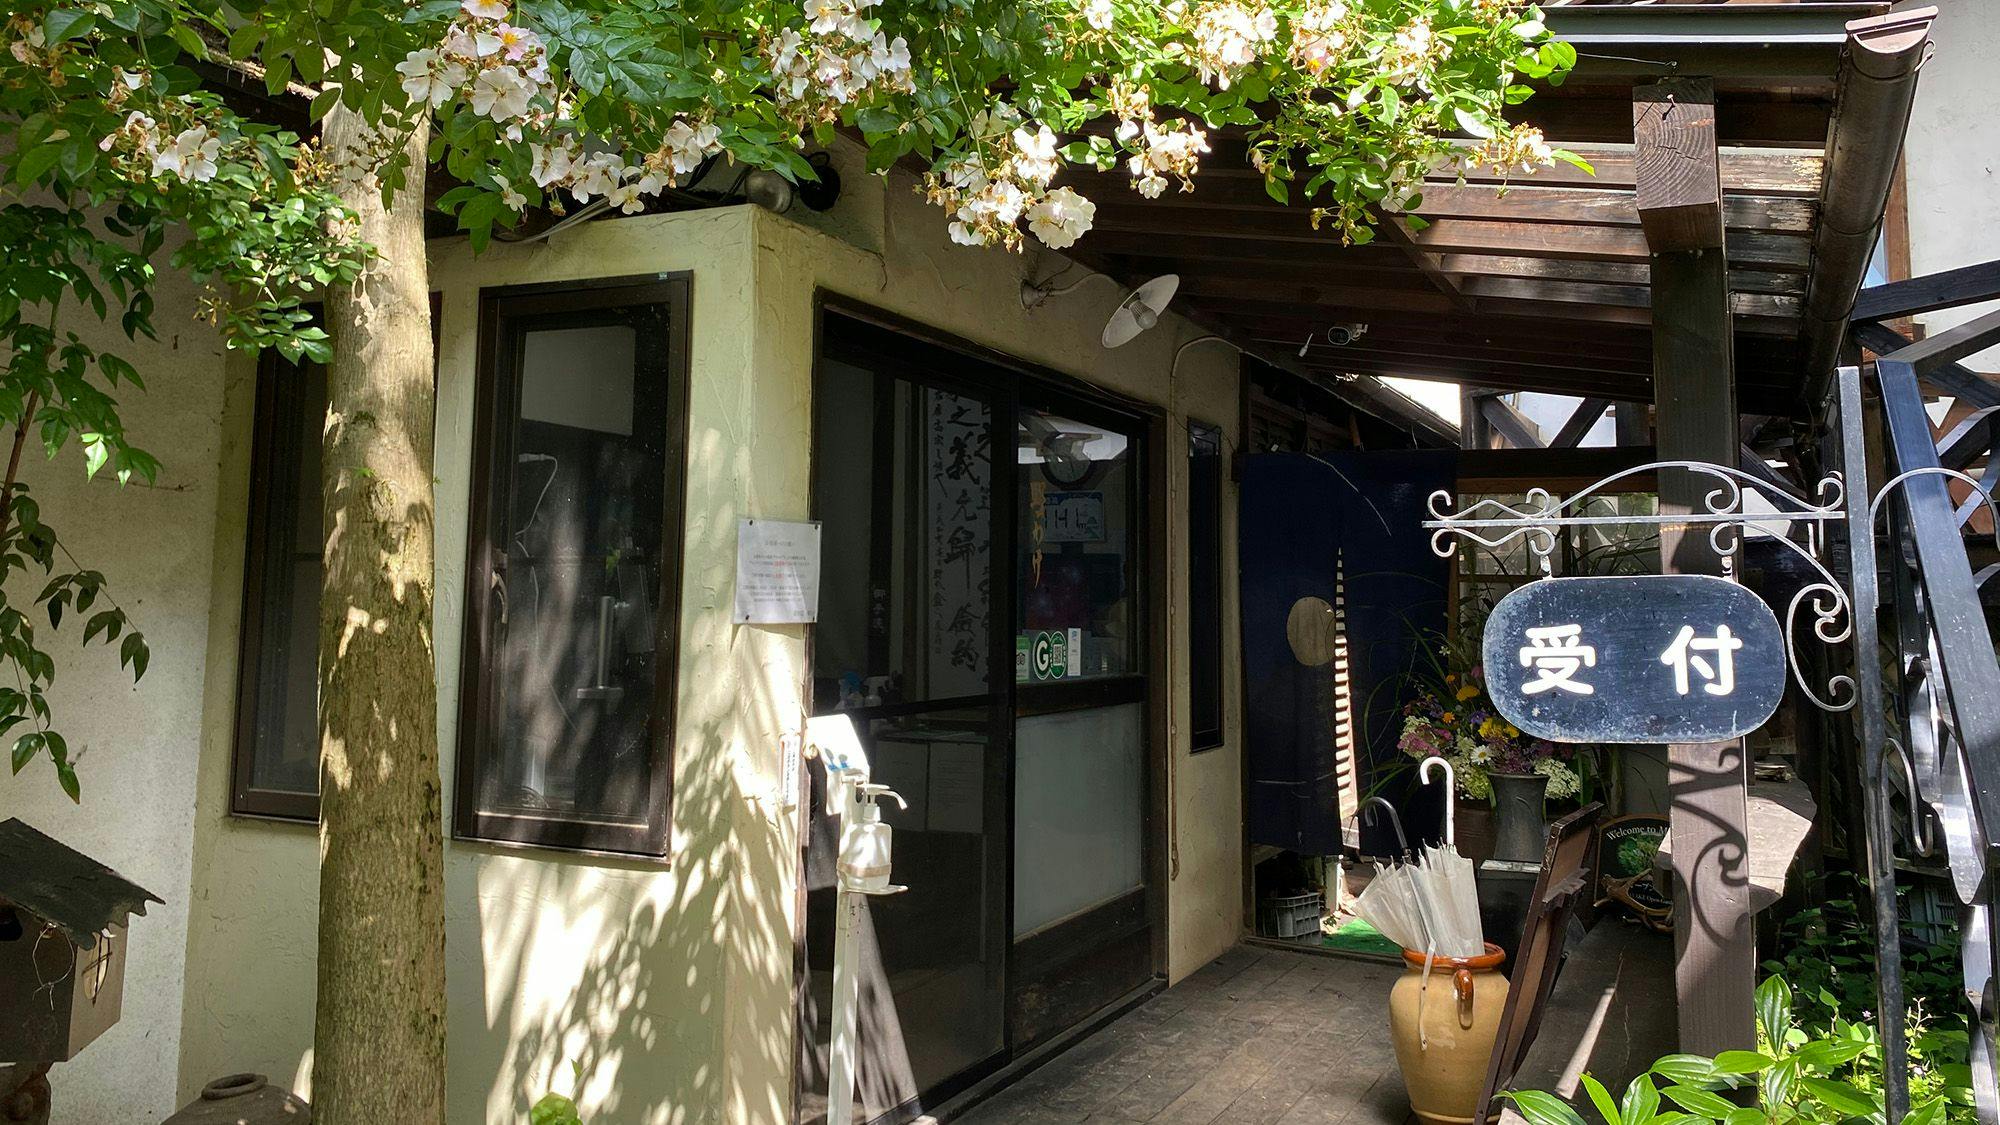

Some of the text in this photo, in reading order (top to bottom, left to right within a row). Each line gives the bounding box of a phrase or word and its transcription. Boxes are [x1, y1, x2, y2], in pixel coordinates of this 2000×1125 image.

[1519, 623, 1743, 697] 受付
[1606, 826, 1645, 840] Welcome
[1647, 826, 1657, 834] to
